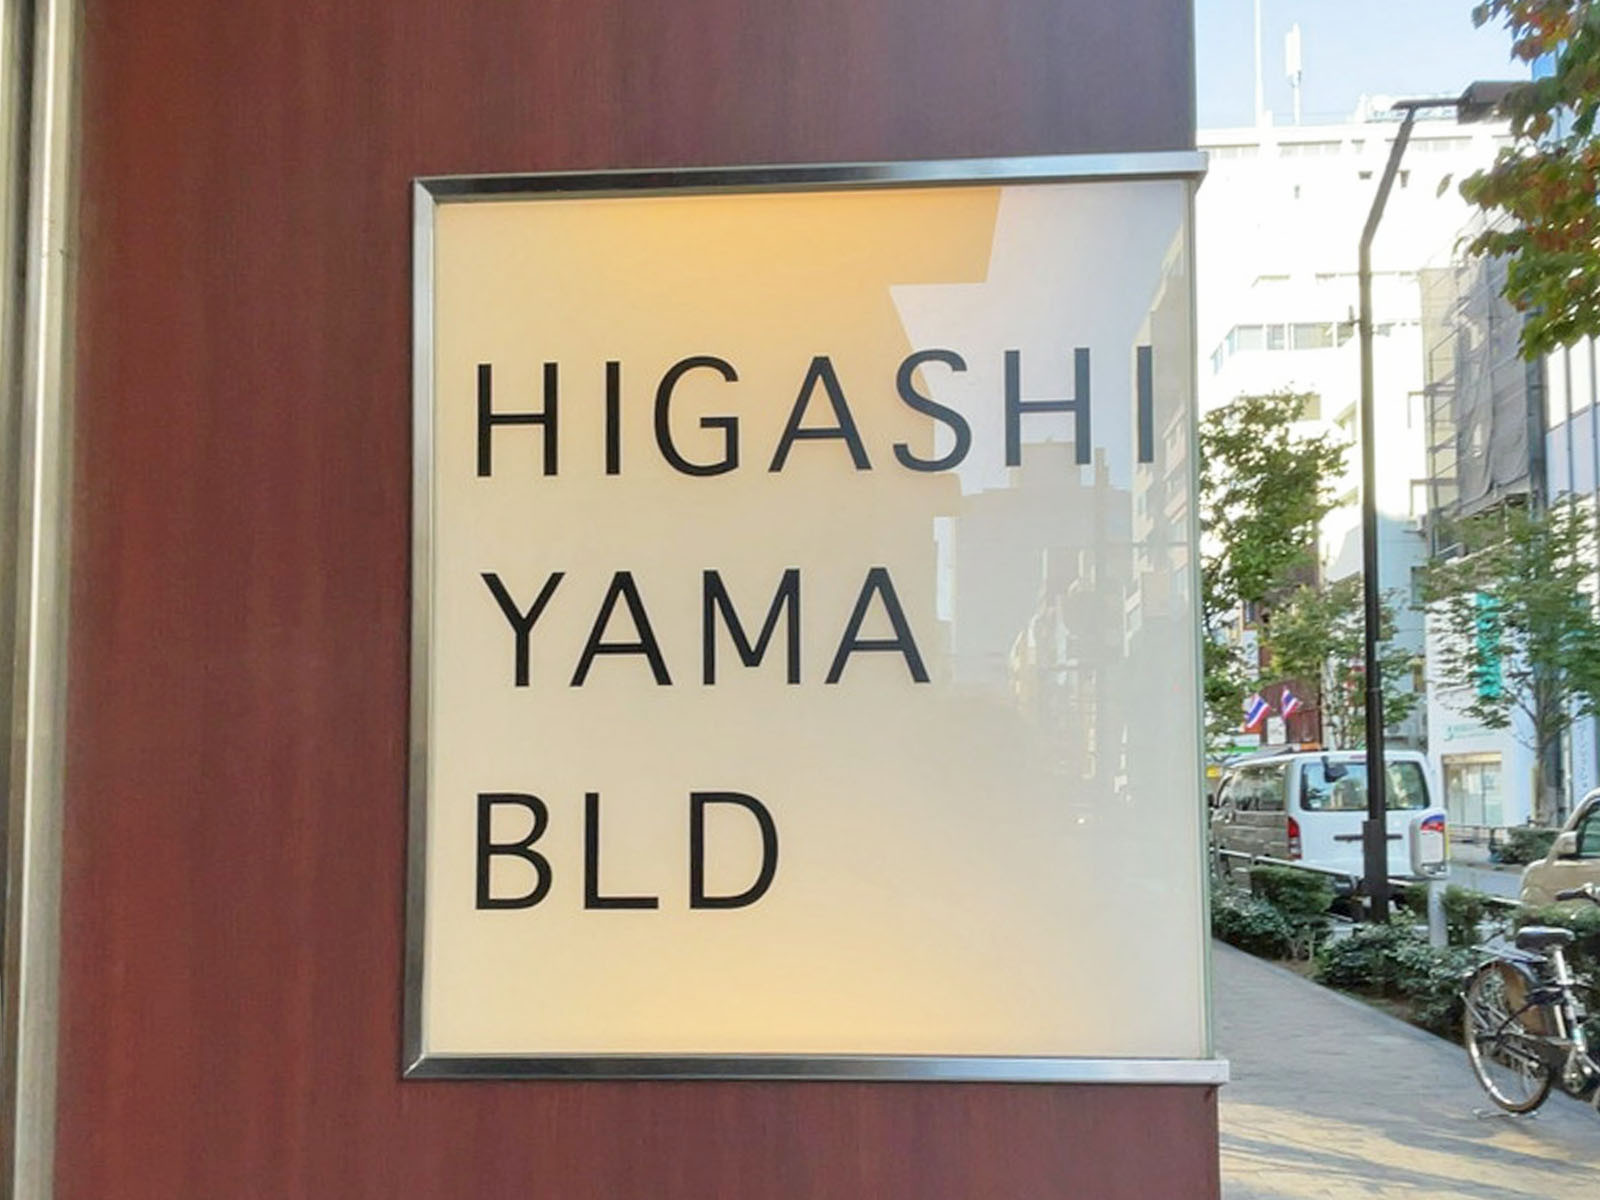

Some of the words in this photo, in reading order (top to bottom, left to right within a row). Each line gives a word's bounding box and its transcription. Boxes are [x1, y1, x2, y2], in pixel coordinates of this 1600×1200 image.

[477, 346, 1154, 477] HIGASHI
[480, 567, 932, 688] YAMA
[475, 791, 779, 911] BLD
